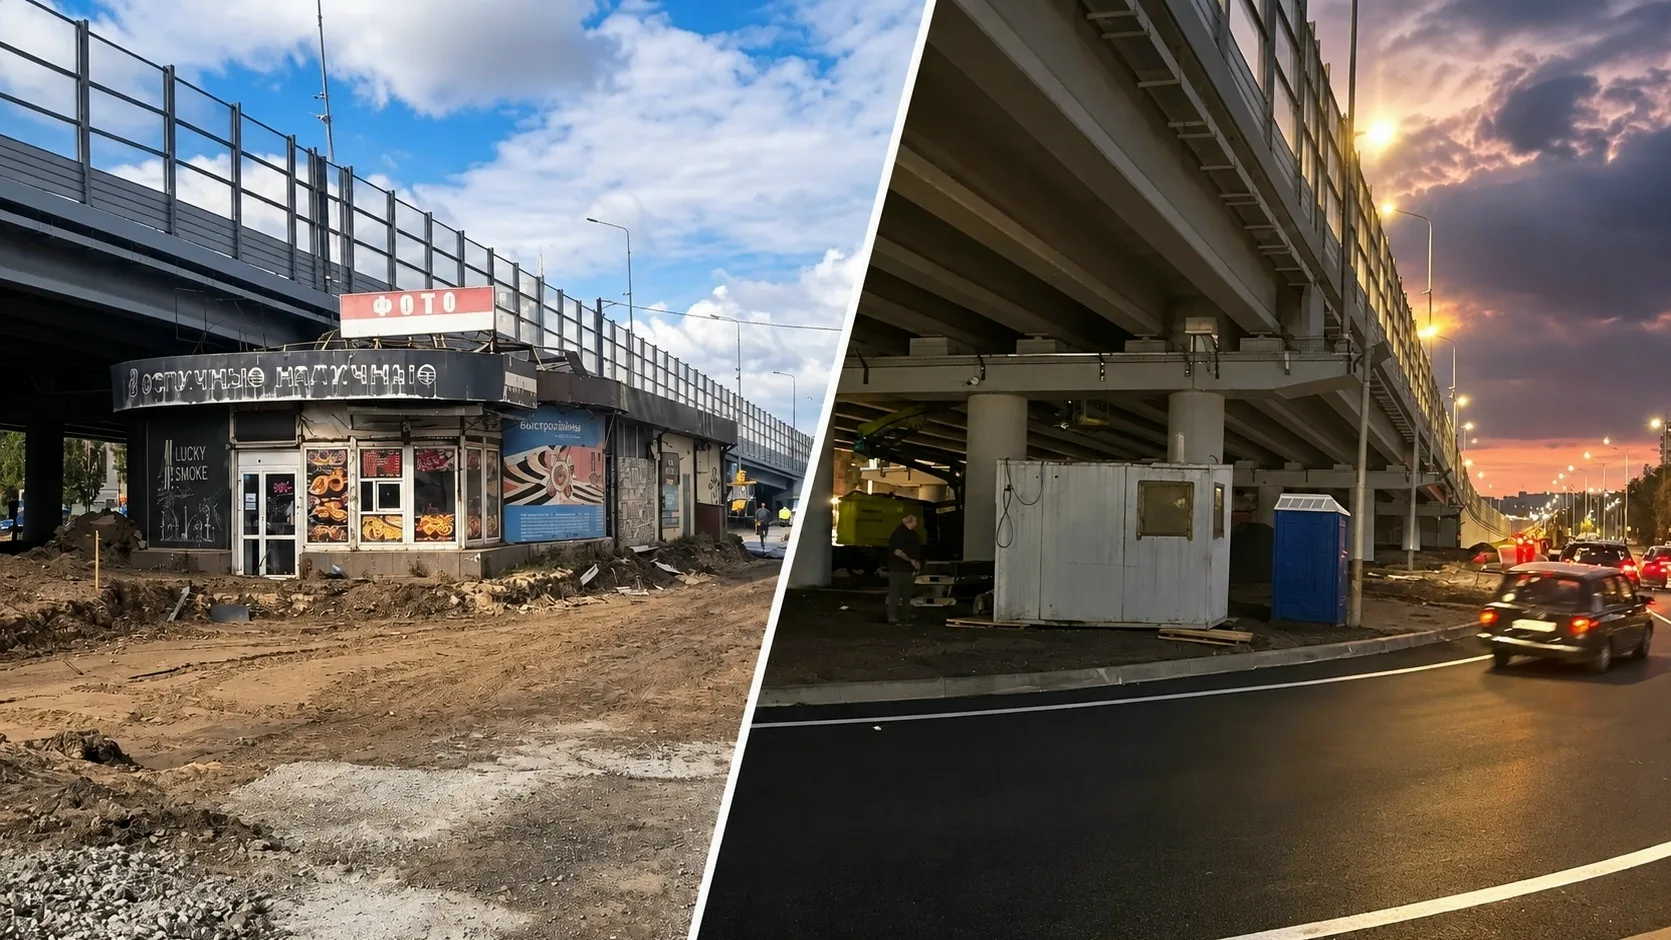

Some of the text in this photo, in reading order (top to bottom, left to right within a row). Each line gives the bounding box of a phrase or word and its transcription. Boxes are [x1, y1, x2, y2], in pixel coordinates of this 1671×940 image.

[373, 292, 456, 317] ФОТО
[175, 445, 207, 461] LUCKY
[175, 465, 209, 481] SMOKE
